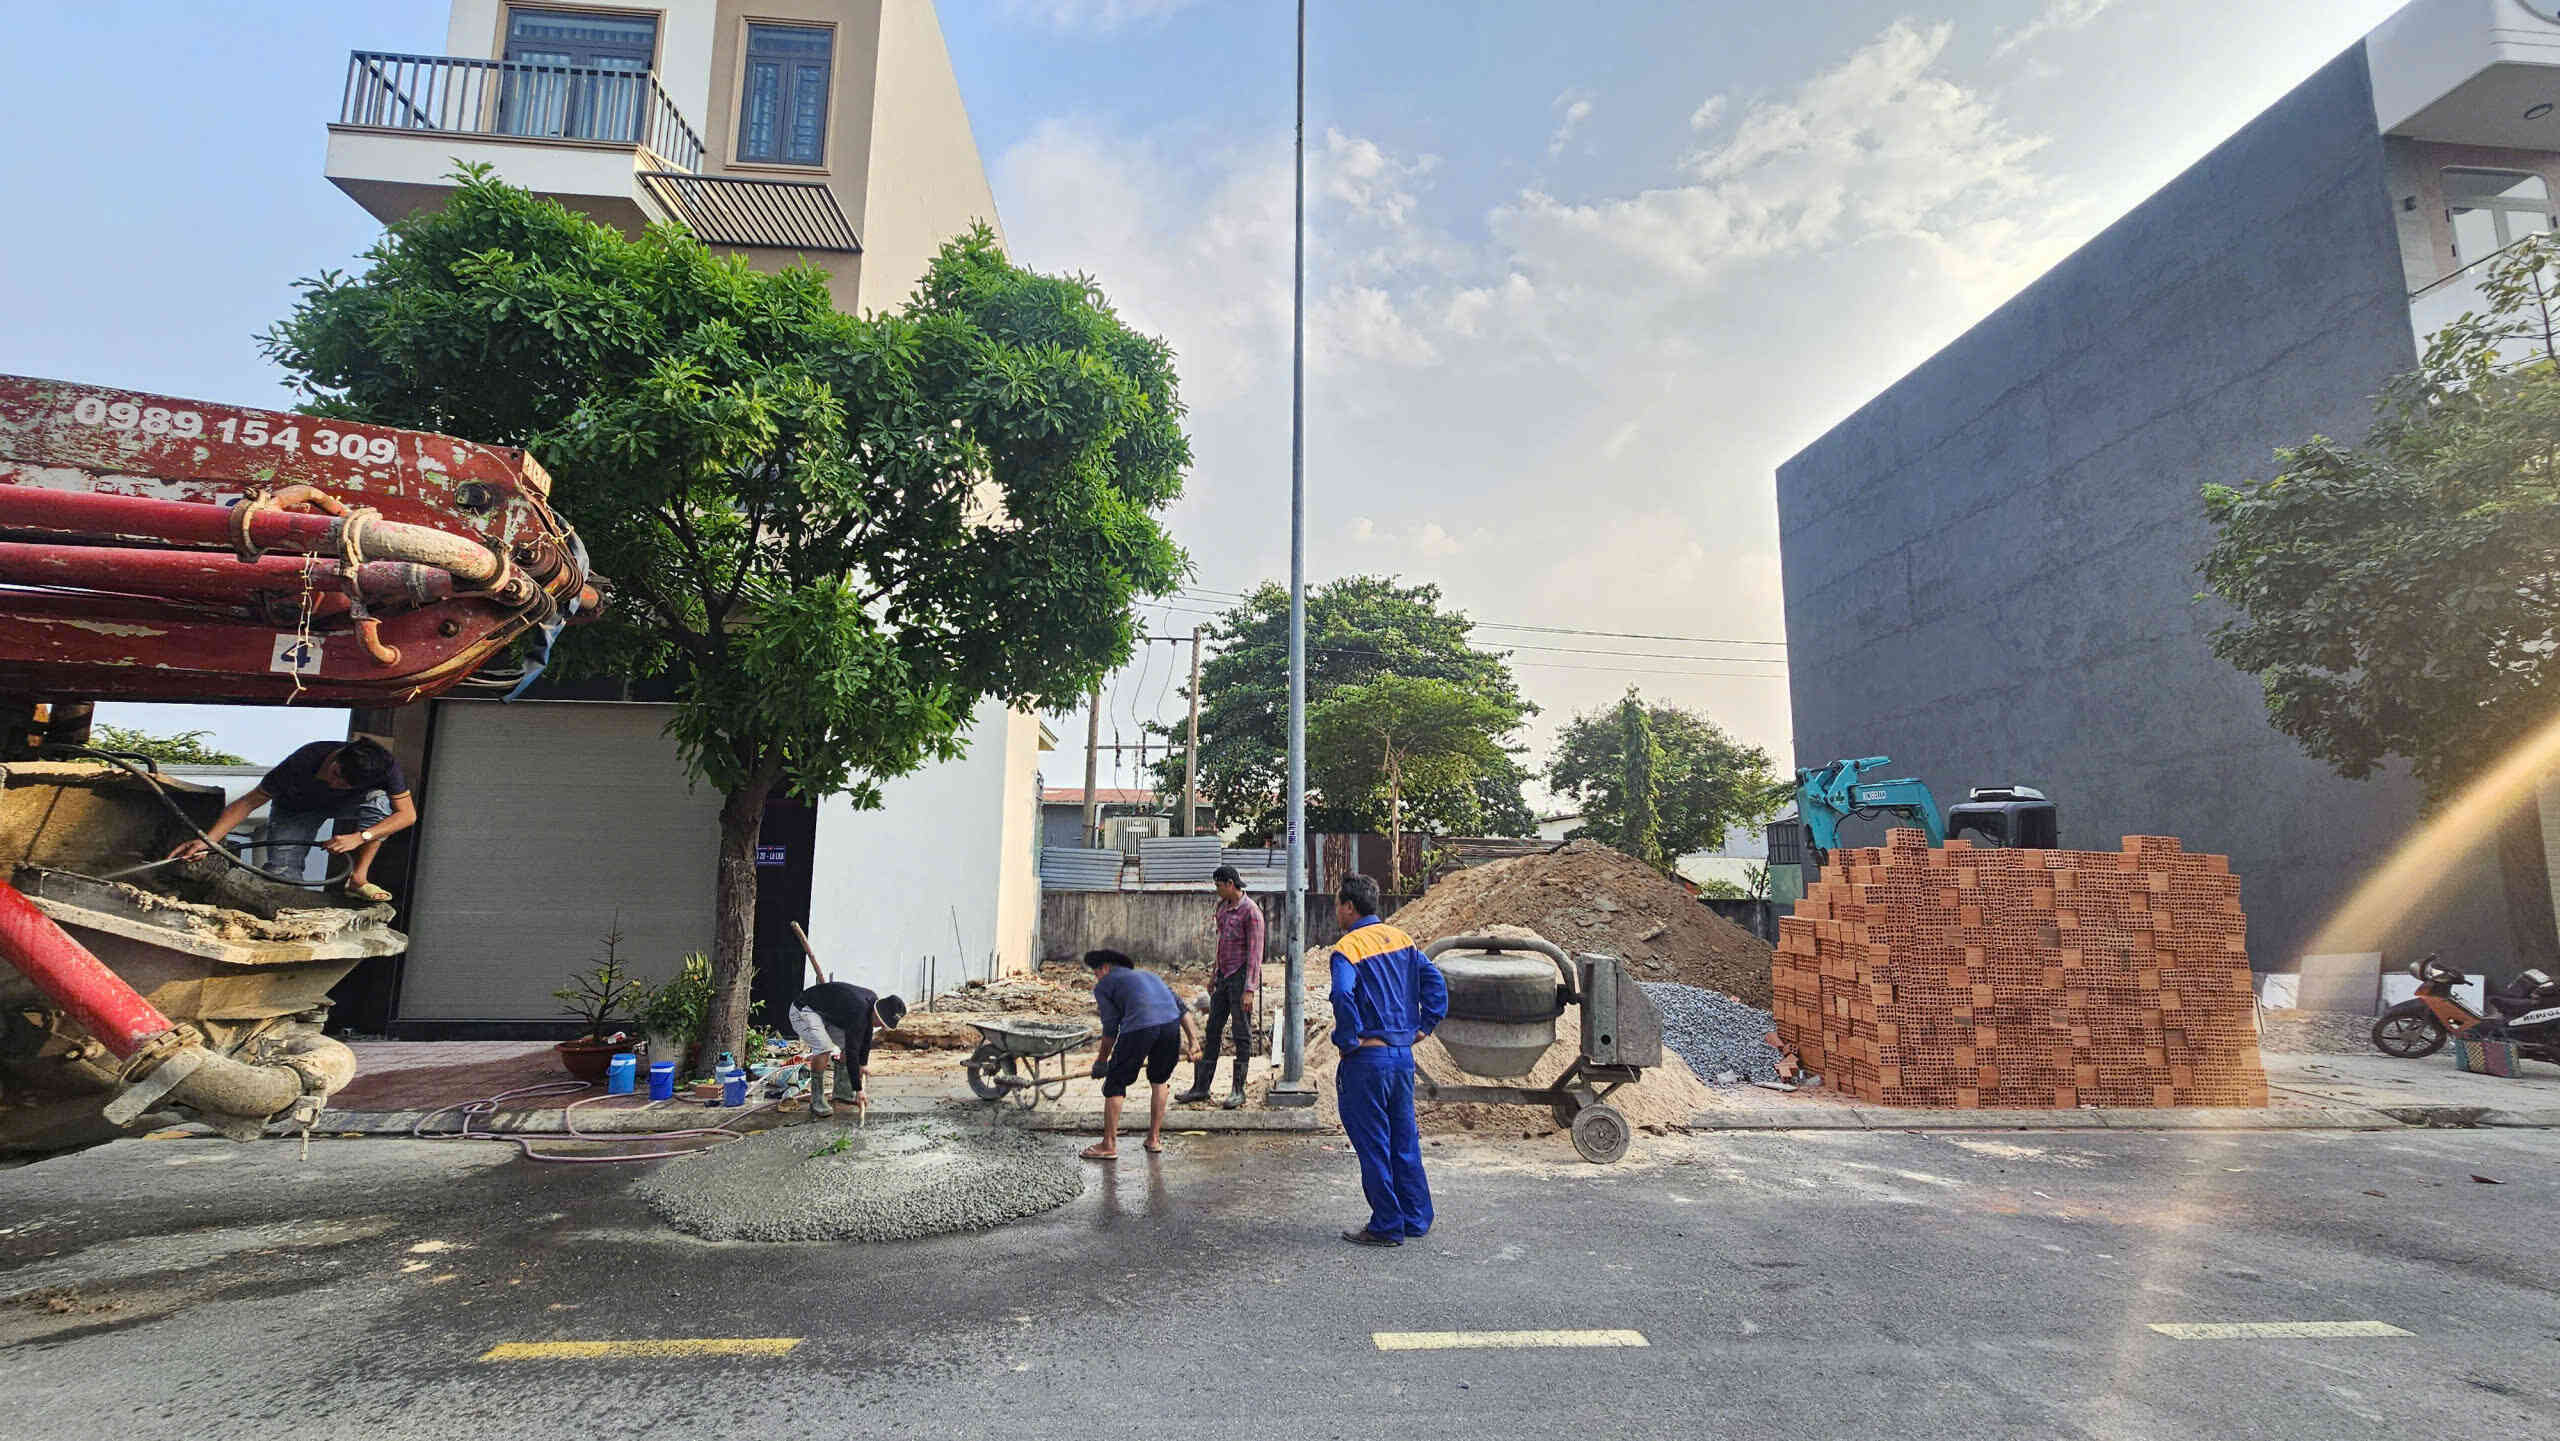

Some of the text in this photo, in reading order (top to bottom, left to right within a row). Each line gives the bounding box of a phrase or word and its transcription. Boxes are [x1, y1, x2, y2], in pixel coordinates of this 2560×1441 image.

[75, 397, 395, 467] 0989 154 309
[281, 640, 311, 668] 4
